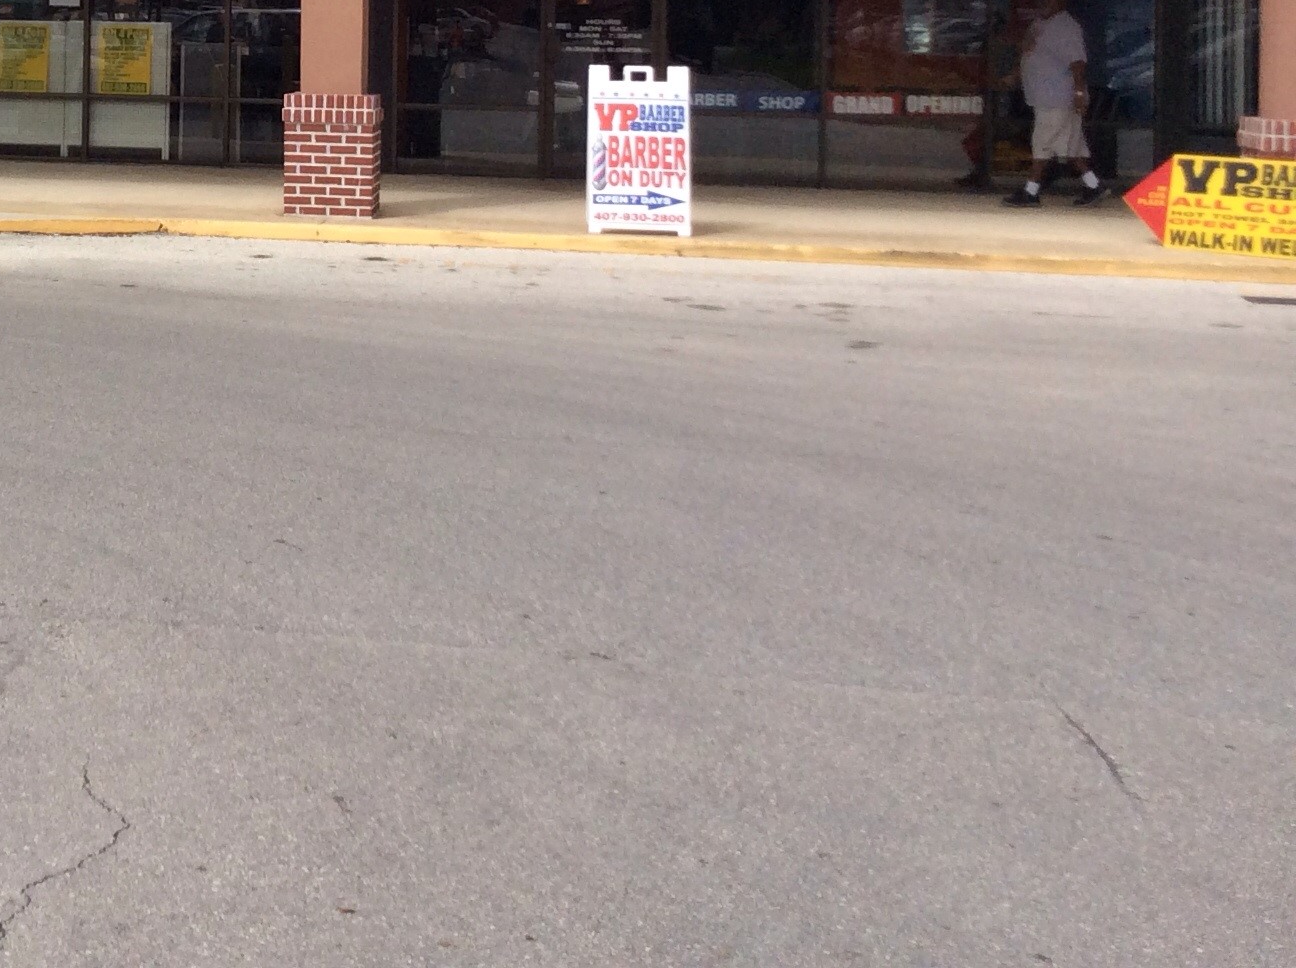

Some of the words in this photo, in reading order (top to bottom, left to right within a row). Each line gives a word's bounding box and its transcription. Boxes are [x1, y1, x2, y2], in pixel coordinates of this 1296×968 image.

[690, 93, 738, 107] RBER
[758, 95, 805, 110] SHOP
[906, 95, 984, 115] OPENING
[594, 103, 638, 131] VP
[639, 104, 685, 123] BARBER
[630, 122, 684, 132] SHOP
[608, 135, 686, 170] BARBER
[608, 169, 632, 187] ON
[640, 170, 686, 189] DUTY
[1177, 159, 1258, 196] VP
[1261, 163, 1296, 187] BA
[596, 195, 629, 204] OPEN
[630, 196, 637, 204] 7
[640, 196, 672, 205] DAYS
[1240, 185, 1296, 200] SH
[1172, 197, 1232, 210] ALL
[1244, 202, 1296, 215] CU
[1169, 218, 1235, 230] OPEN
[1171, 210, 1205, 218] HOT
[1213, 213, 1270, 224] TOWEL
[1170, 230, 1253, 253] WALK-IN
